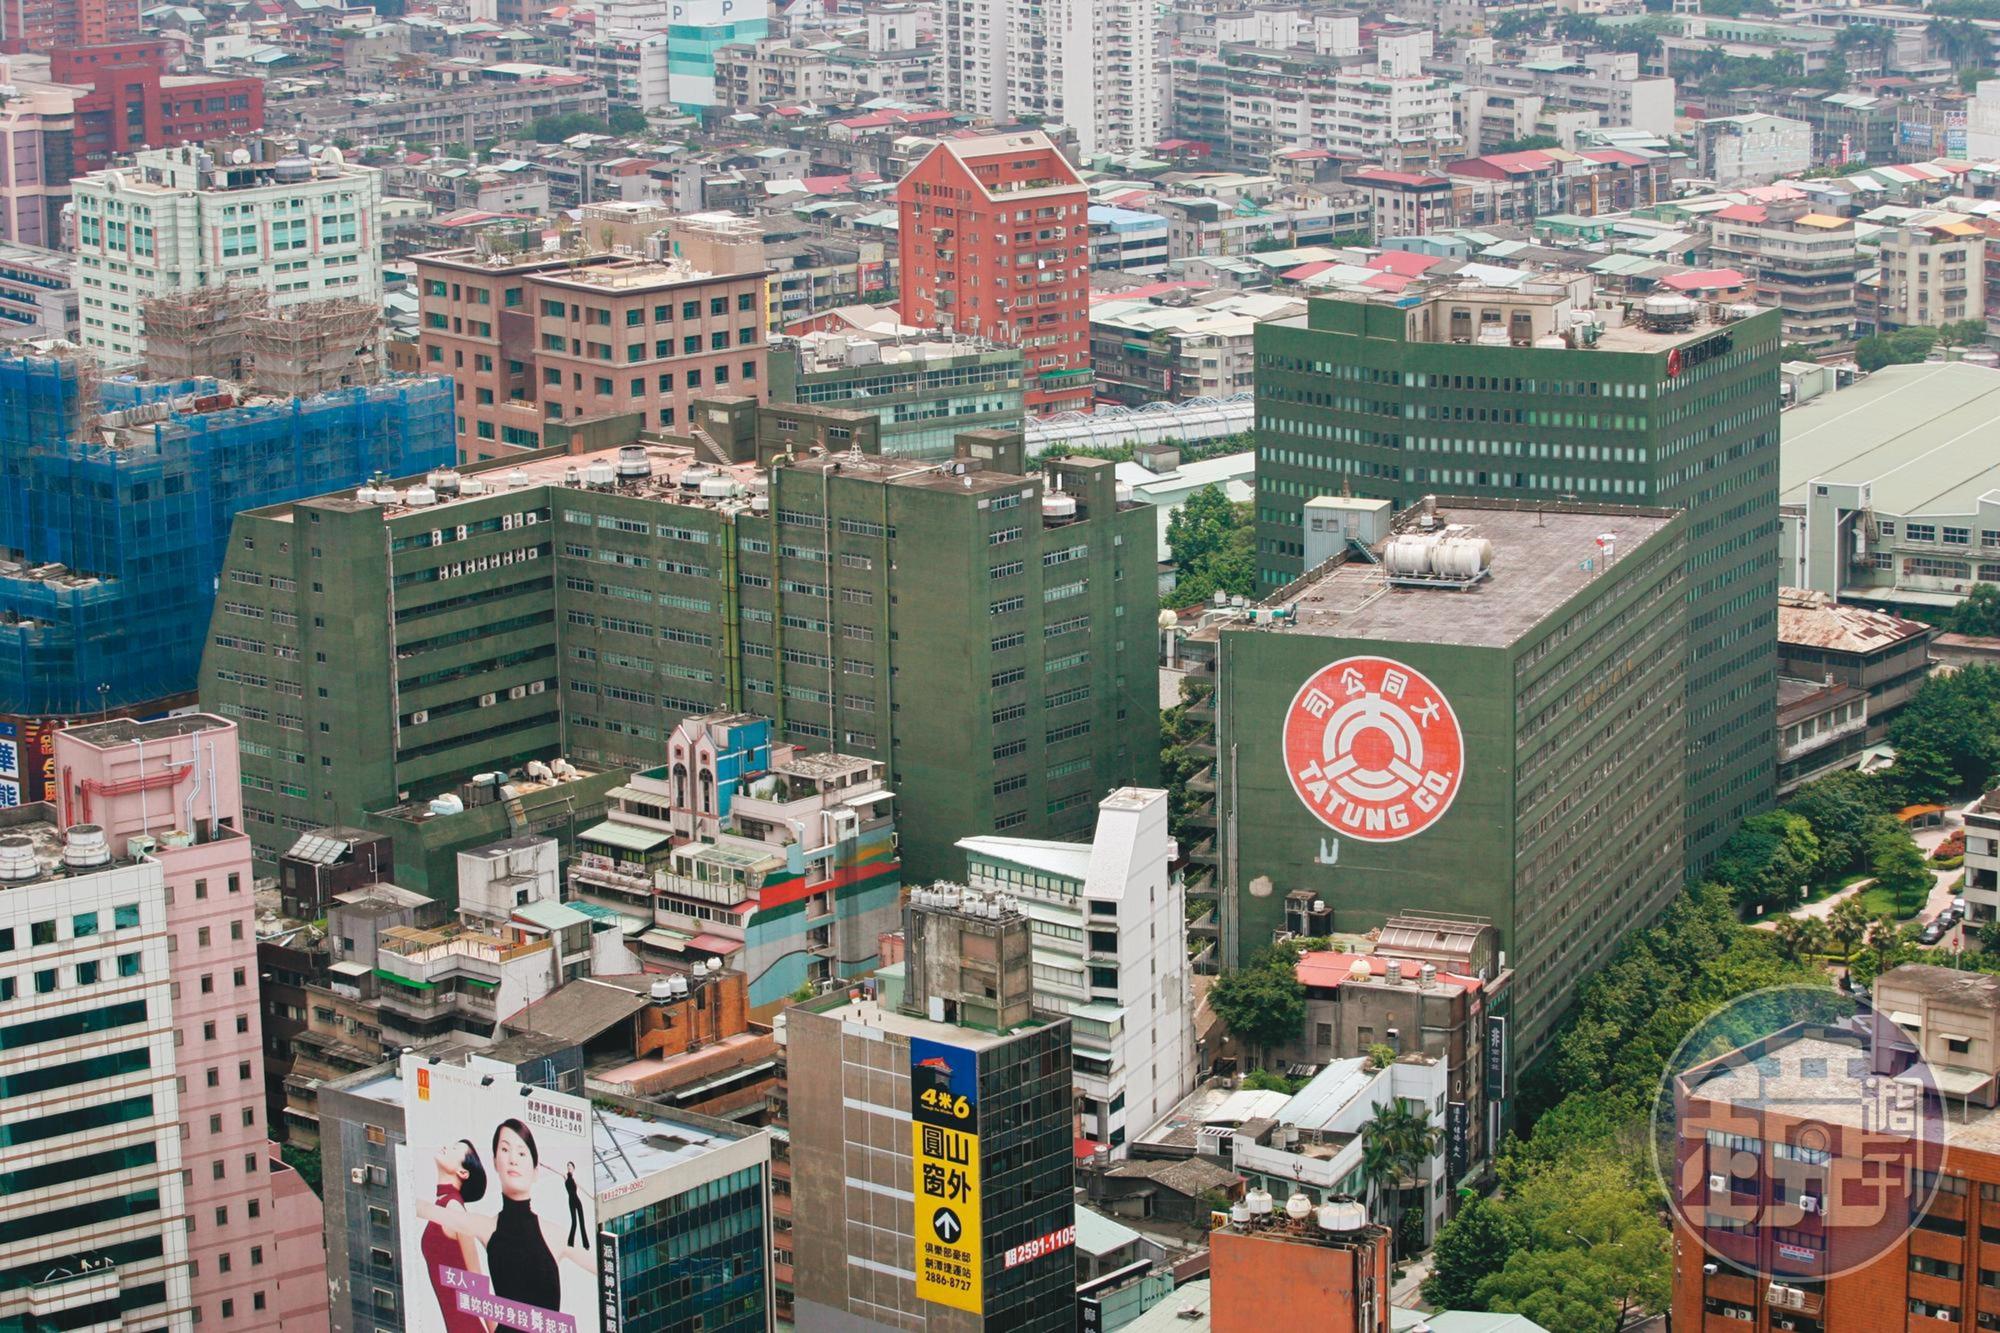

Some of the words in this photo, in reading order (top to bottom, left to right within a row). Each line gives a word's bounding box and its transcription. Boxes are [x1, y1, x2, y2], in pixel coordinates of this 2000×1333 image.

[673, 6, 682, 20] P
[722, 1, 733, 16] P
[1298, 760, 1410, 831] TATUNG
[1411, 770, 1453, 813] CO.
[528, 1112, 583, 1134] 0800-211-049
[922, 1125, 969, 1166] 圓山
[925, 1271, 971, 1291] 2886-8727
